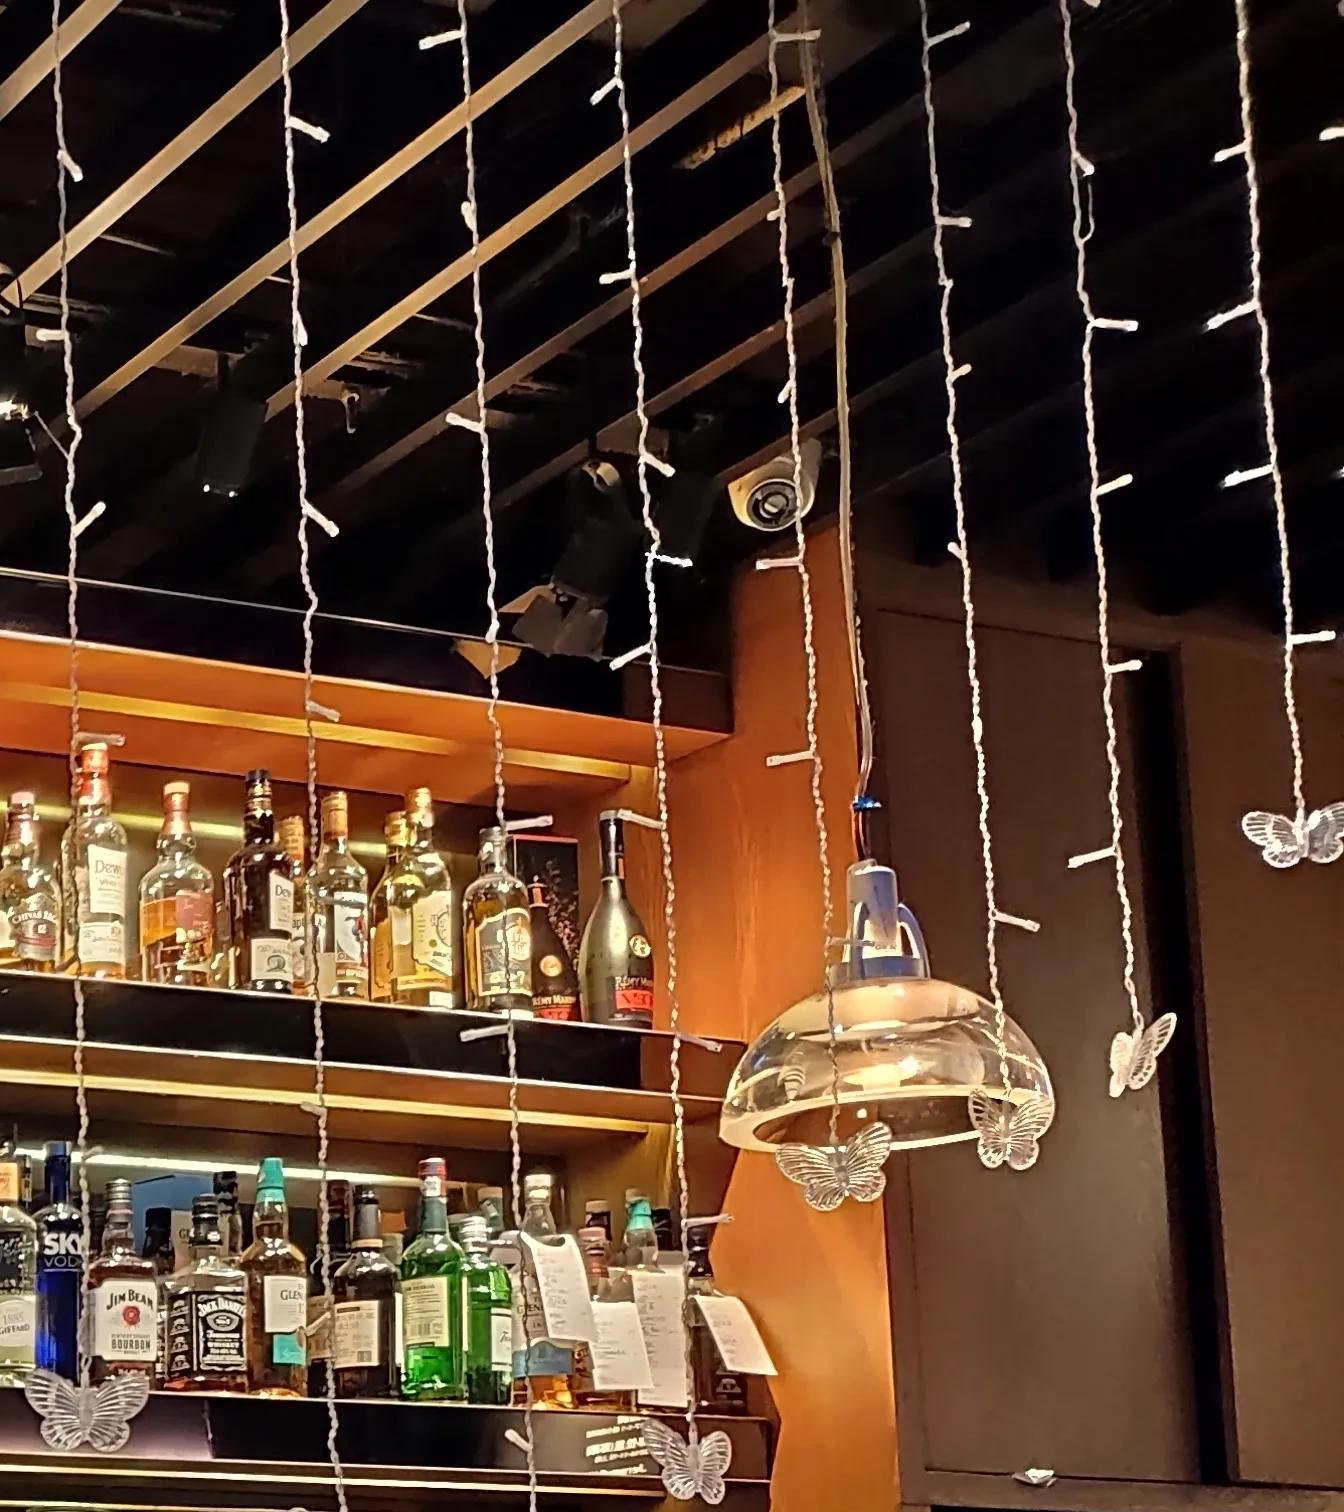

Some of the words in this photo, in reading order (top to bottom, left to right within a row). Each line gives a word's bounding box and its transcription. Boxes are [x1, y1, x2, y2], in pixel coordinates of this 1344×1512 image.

[106, 1293, 126, 1311] JIM
[128, 1289, 153, 1309] BEAM
[111, 1339, 151, 1351] BOURBON
